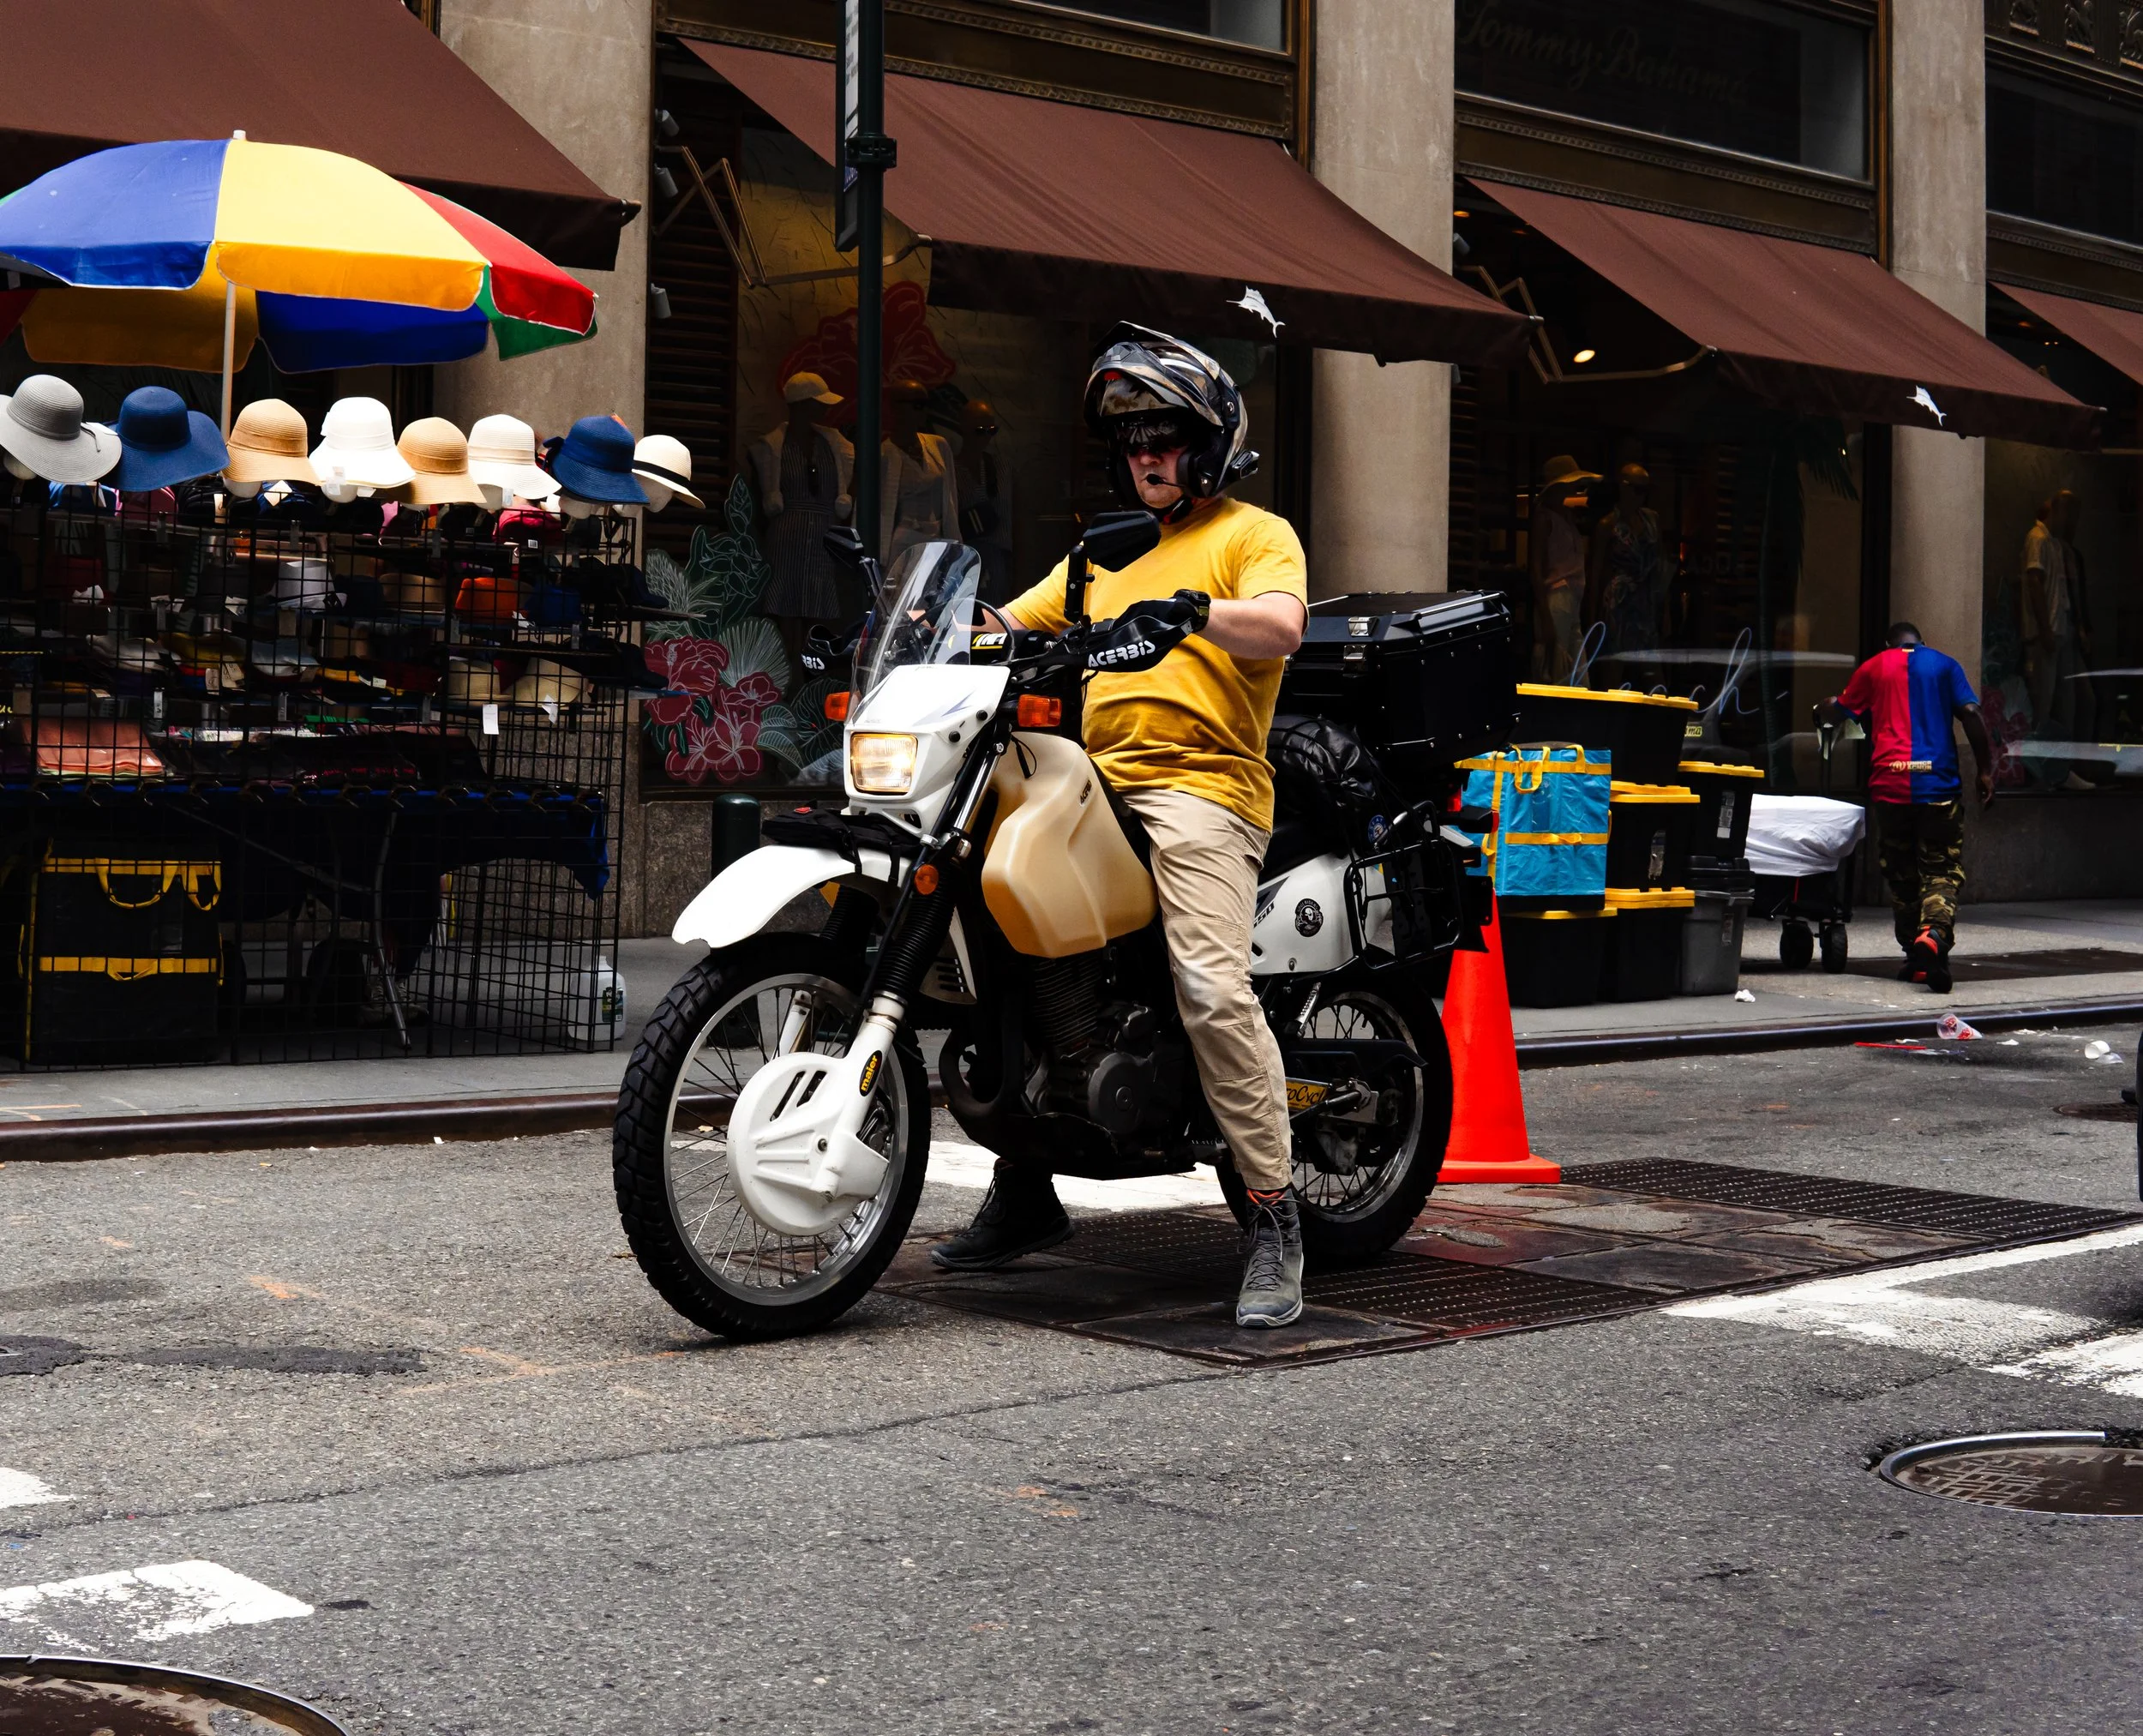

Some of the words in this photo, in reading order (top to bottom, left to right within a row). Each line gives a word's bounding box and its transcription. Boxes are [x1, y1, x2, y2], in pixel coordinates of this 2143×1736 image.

[1456, 0, 1592, 91] Tommy
[1254, 901, 1275, 928] 50
[861, 1054, 878, 1091] maier
